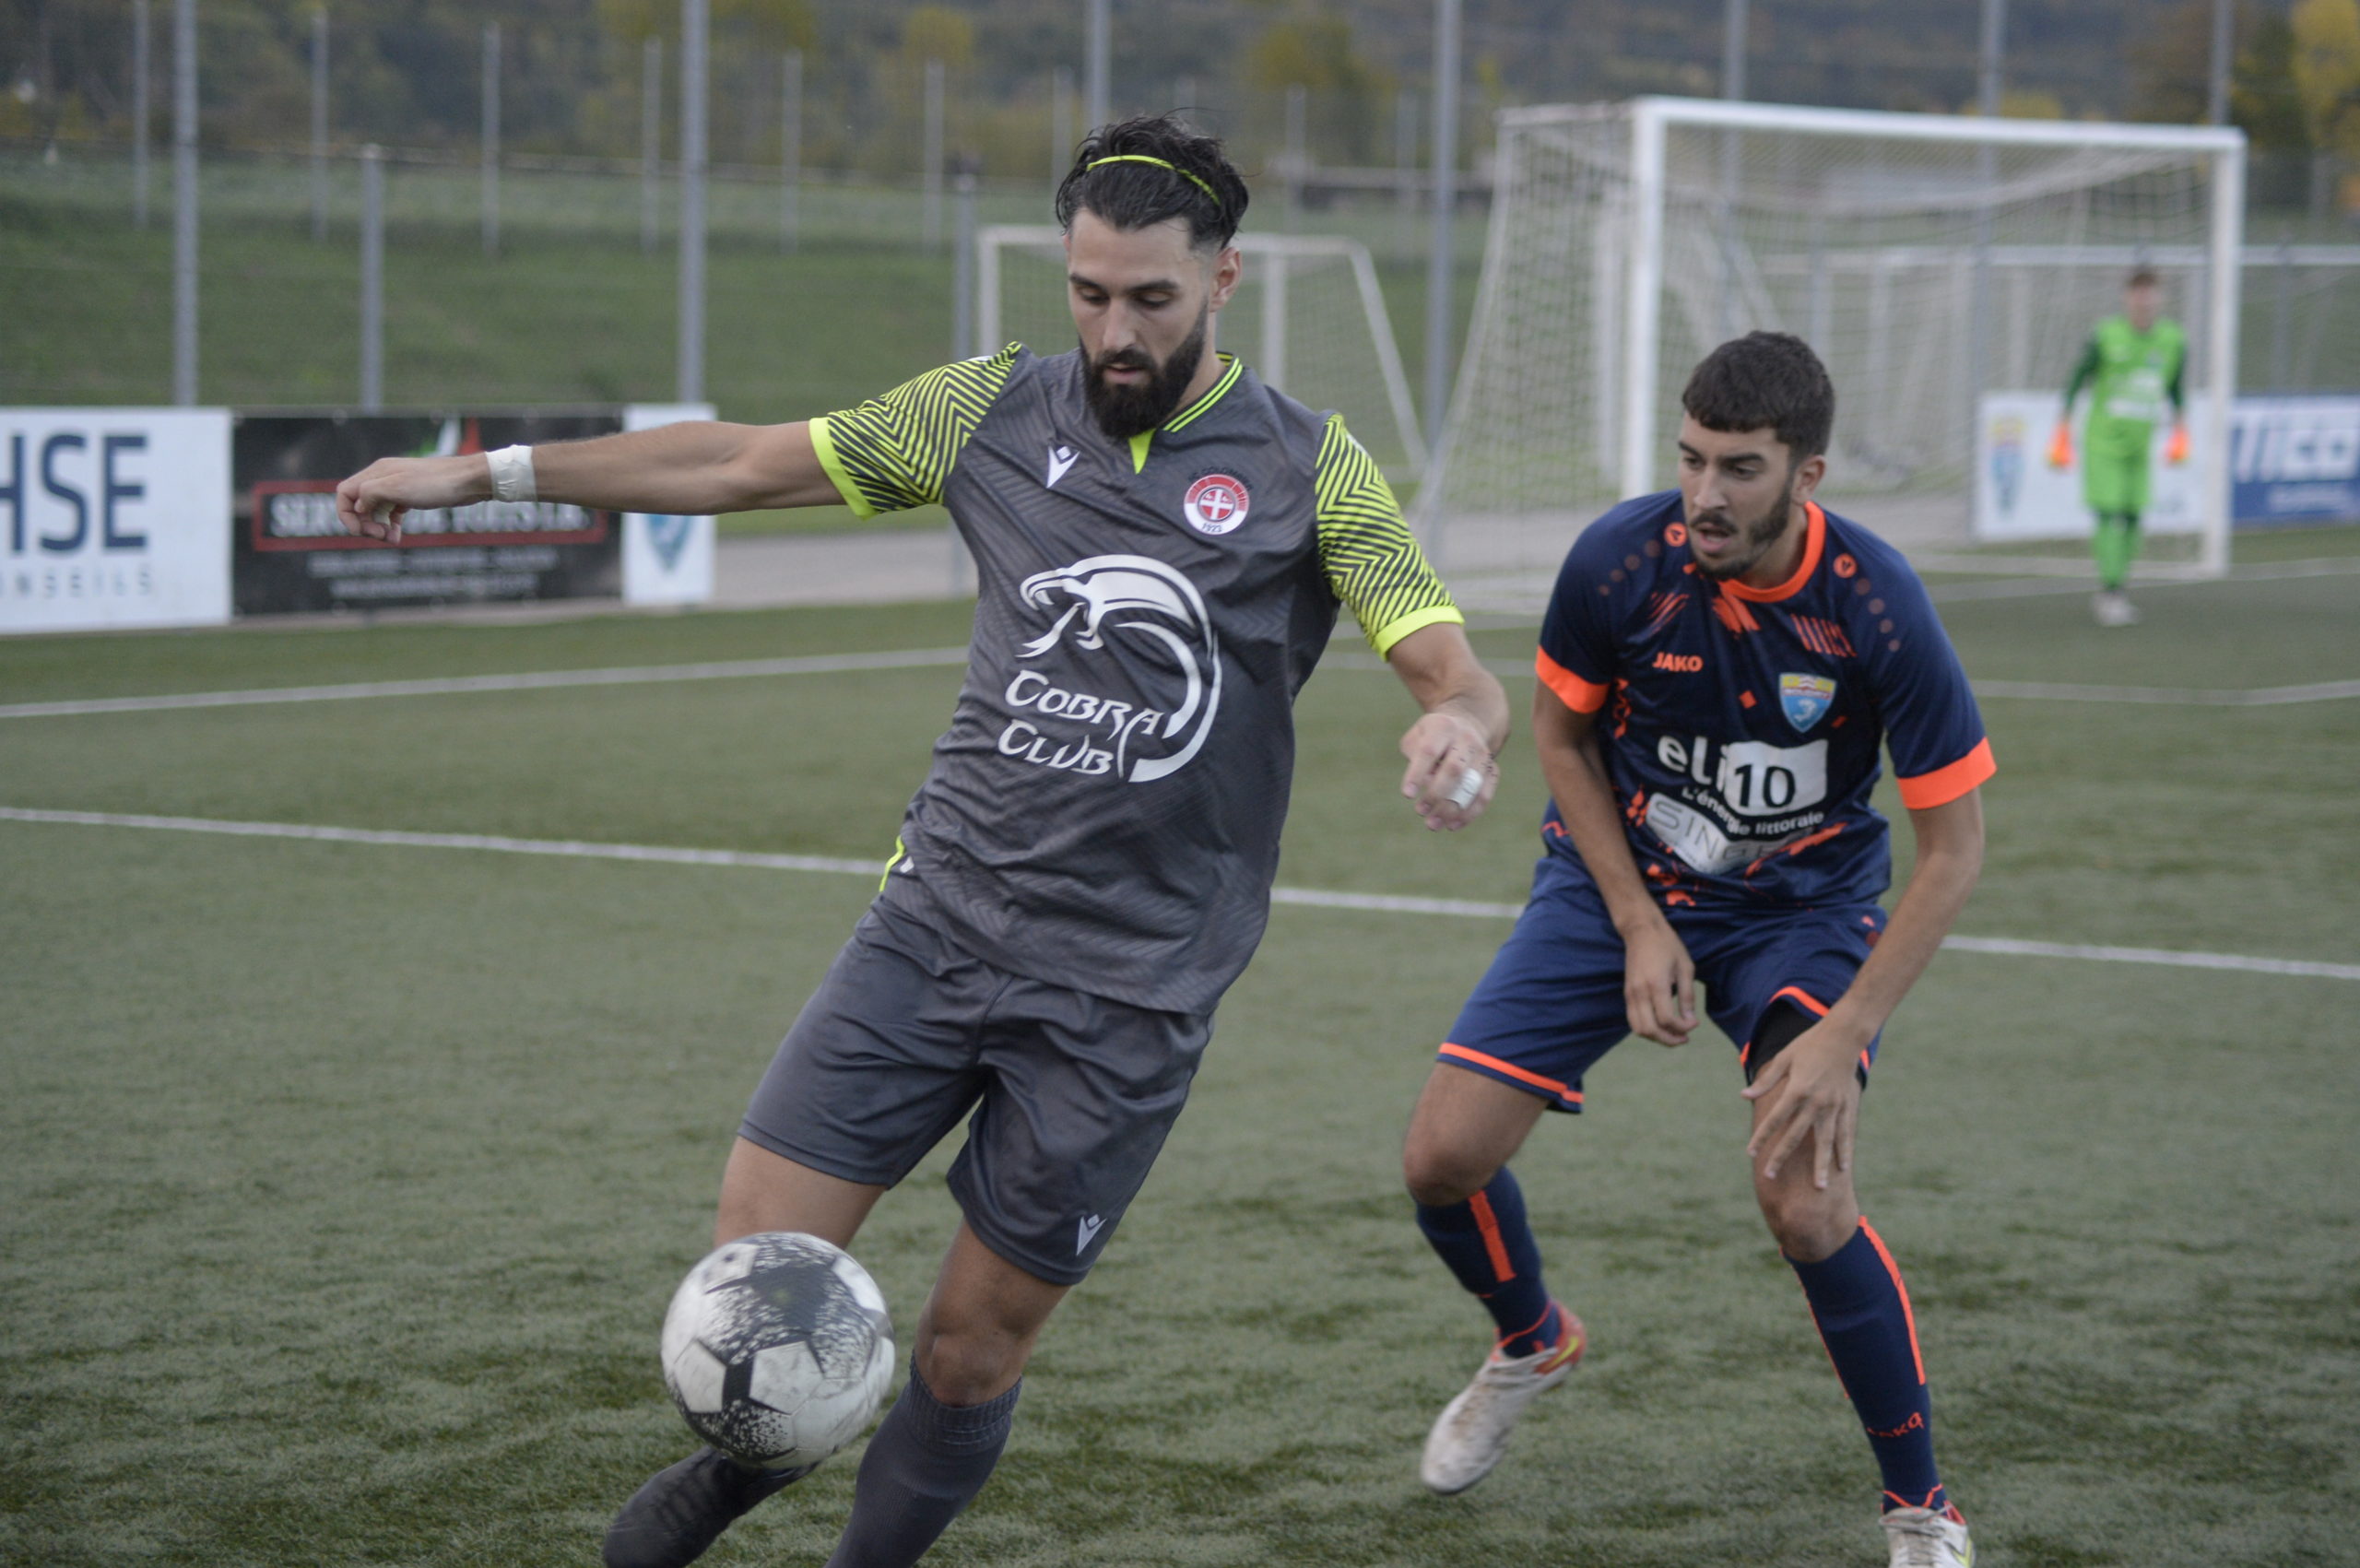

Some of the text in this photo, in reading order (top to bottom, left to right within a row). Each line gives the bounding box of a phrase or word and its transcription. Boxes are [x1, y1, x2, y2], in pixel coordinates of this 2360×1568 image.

[1652, 652, 1704, 672] JAKO
[1005, 669, 1163, 741] COBRA
[998, 718, 1114, 774] CLUB
